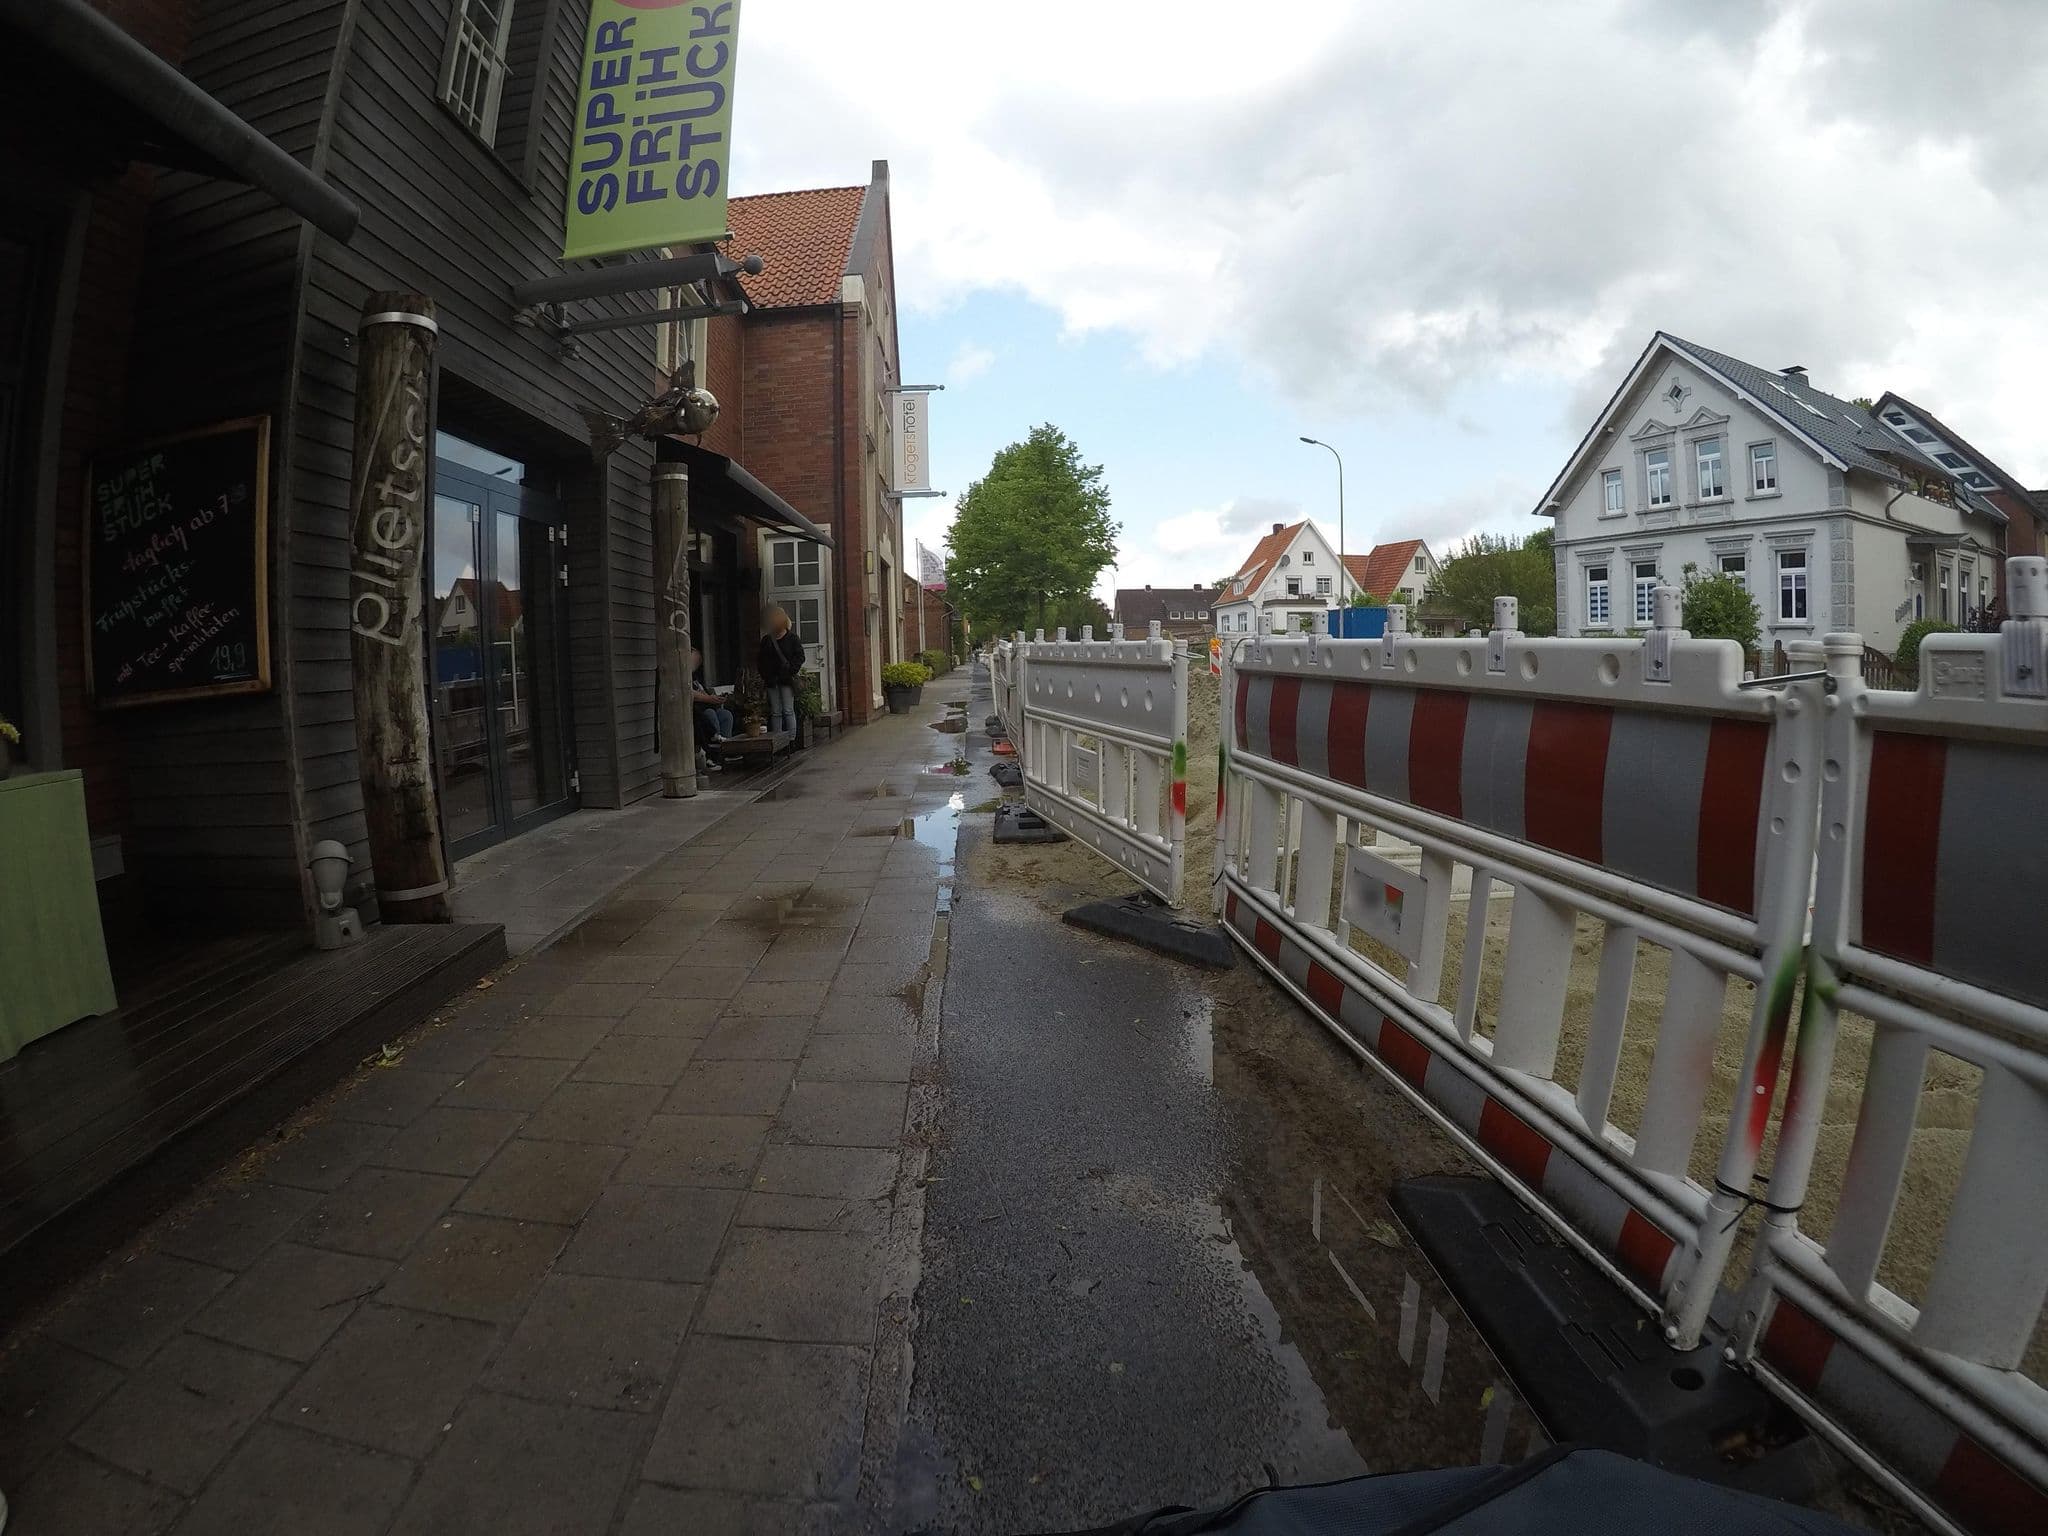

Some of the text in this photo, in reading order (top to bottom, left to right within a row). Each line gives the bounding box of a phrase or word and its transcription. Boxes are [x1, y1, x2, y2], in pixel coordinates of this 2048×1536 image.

[577, 16, 637, 215] SUPER
[626, 46, 681, 204] FRÜH
[675, 2, 733, 200] STÜCK
[189, 508, 215, 531] ab
